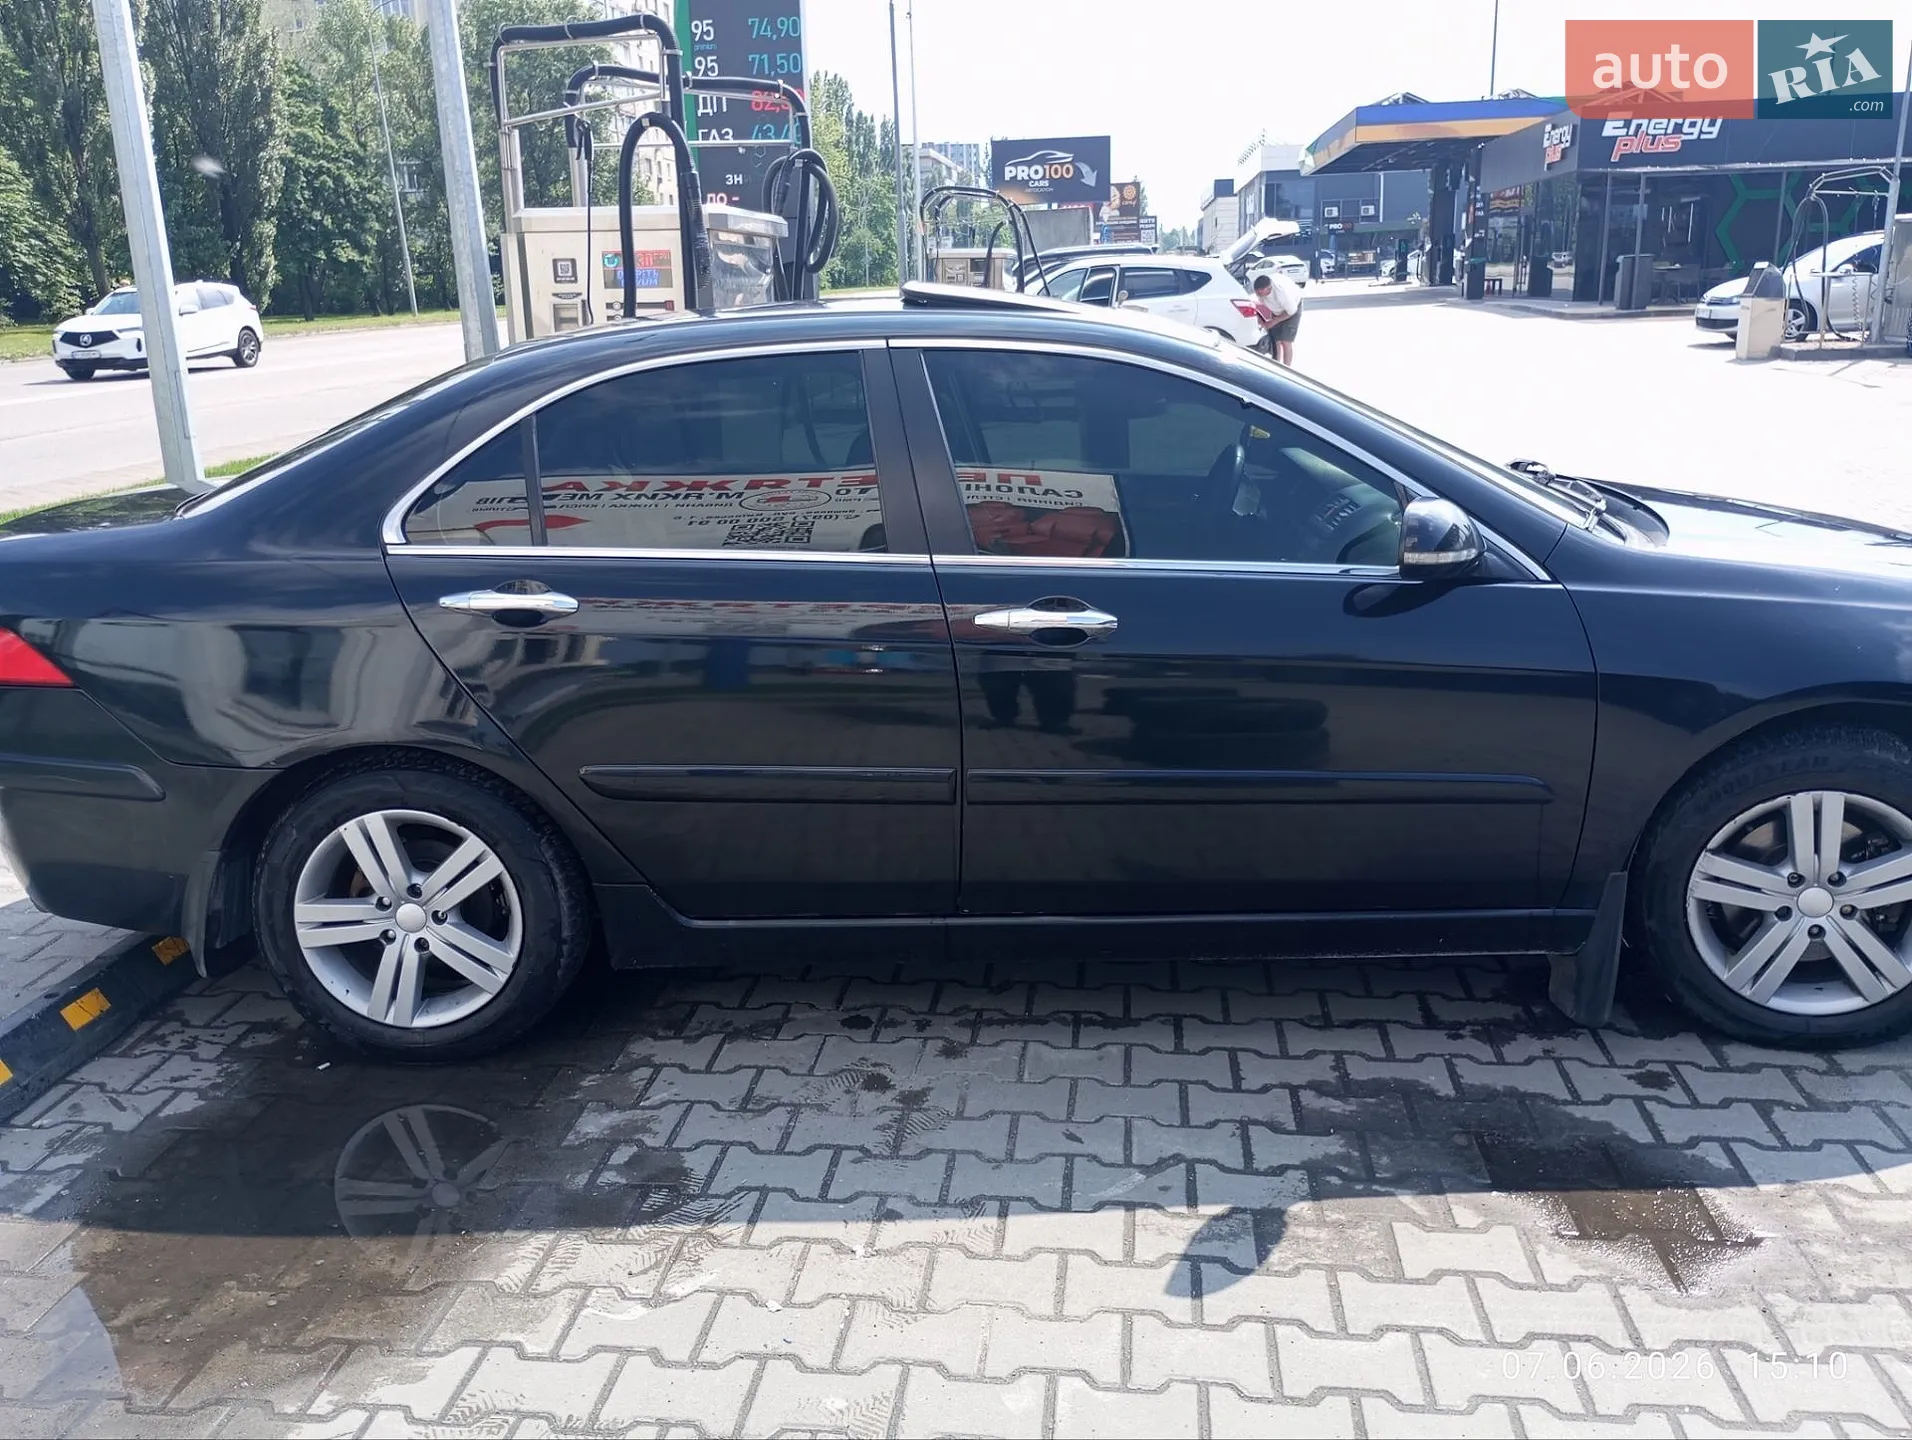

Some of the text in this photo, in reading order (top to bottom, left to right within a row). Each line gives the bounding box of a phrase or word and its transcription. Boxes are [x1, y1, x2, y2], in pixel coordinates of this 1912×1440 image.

[691, 16, 801, 42] 95 74,90
[694, 53, 802, 77] 95 71,50
[697, 94, 727, 117] ДП
[698, 128, 734, 141] ГАЗ
[1543, 123, 1572, 149] Energy
[1602, 111, 1722, 140] Energy
[1611, 129, 1684, 161] plus
[1004, 163, 1074, 182] PRO100
[1028, 179, 1050, 188] CARS
